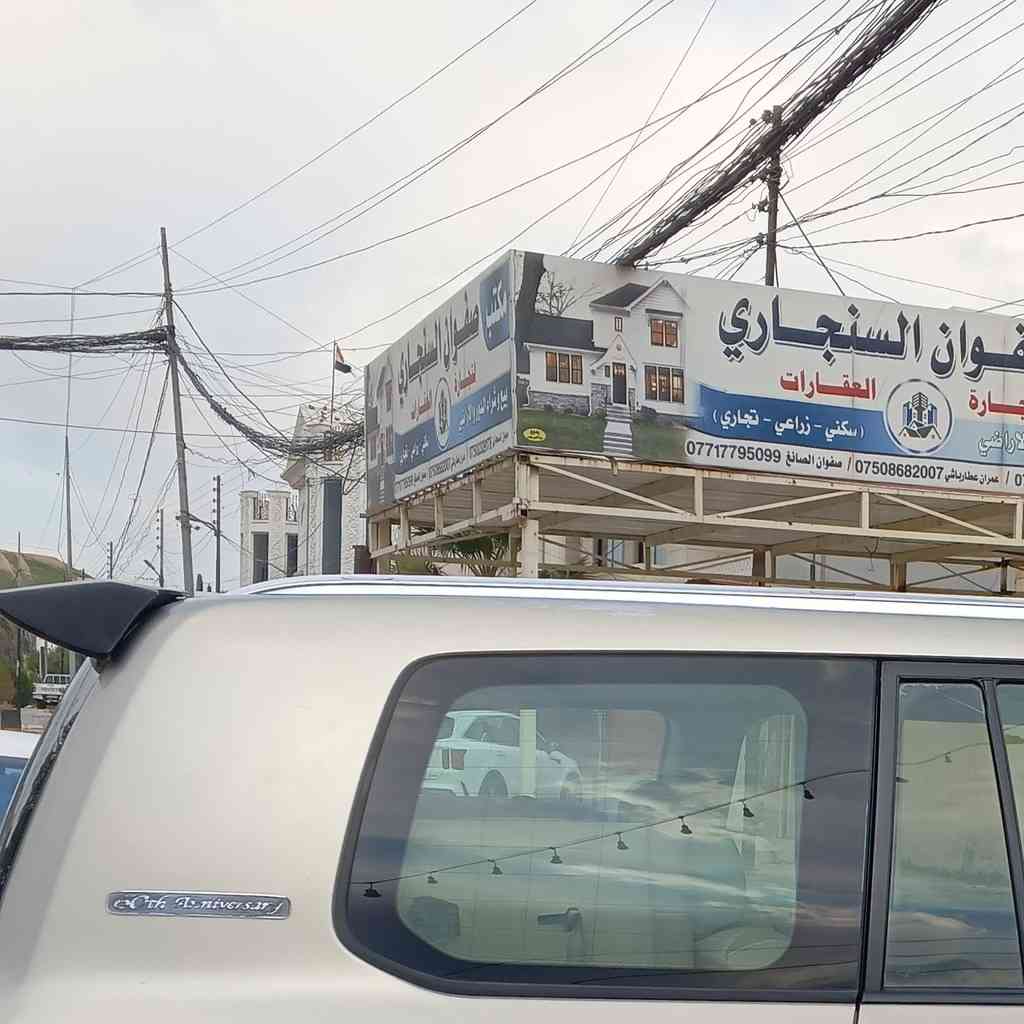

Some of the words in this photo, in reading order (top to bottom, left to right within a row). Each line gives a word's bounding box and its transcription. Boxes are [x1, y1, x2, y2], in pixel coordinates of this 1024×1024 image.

[718, 294, 922, 366] السنجاري
[779, 368, 876, 400] العقارات
[774, 415, 811, 436] زراعي
[686, 440, 782, 464] 07717795099
[854, 458, 944, 480] 07508682007
